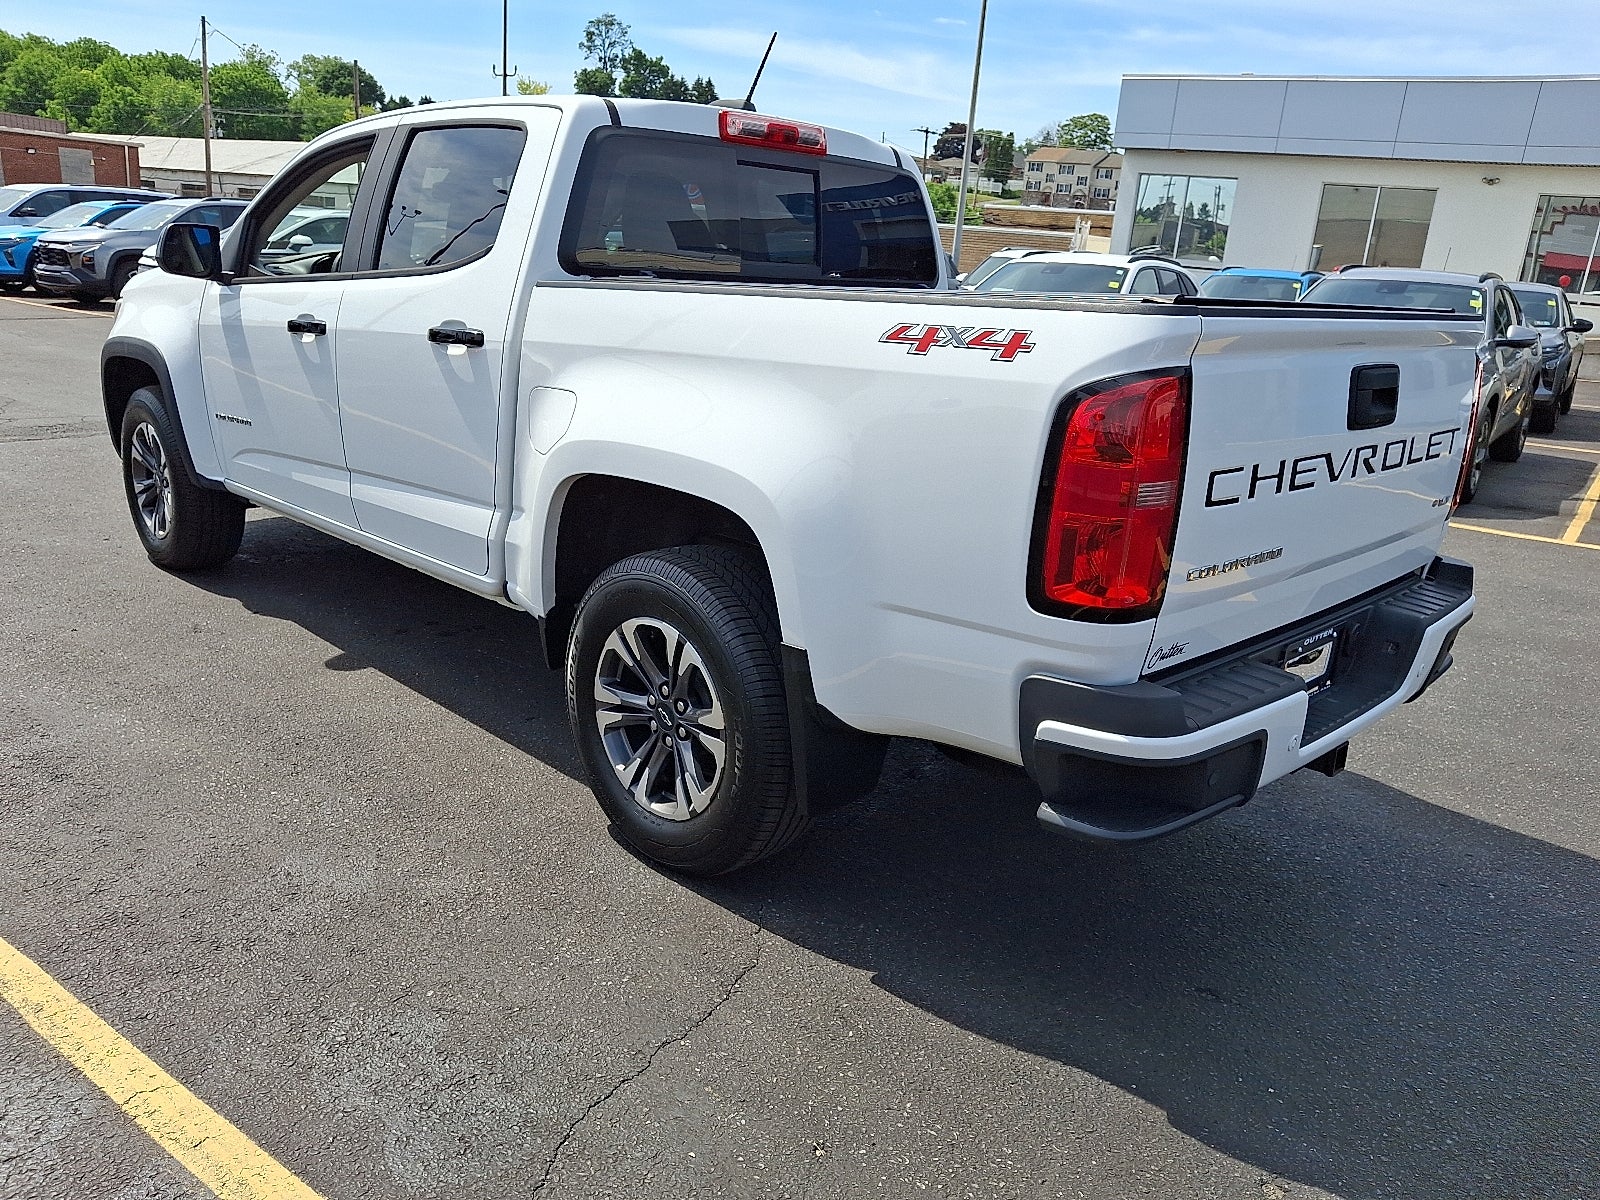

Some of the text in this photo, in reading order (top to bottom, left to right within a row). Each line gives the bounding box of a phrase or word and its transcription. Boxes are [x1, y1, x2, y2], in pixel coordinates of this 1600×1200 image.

[1204, 427, 1461, 508] CHEVROLET
[1186, 546, 1283, 582] COLORADO
[1303, 627, 1334, 646] OUTTEN
